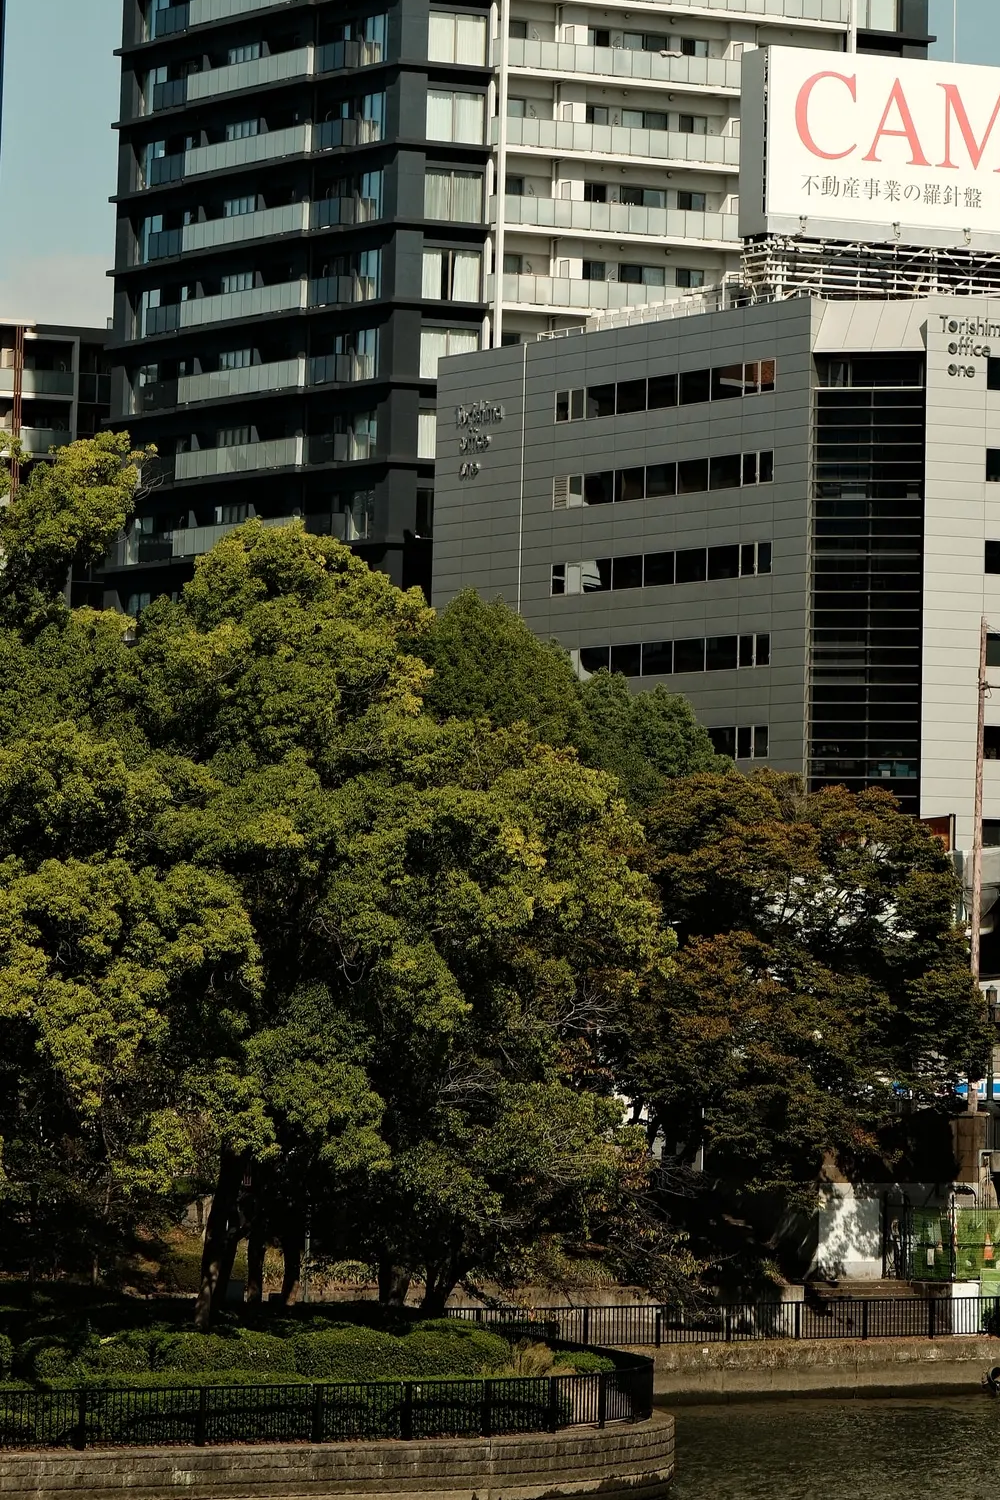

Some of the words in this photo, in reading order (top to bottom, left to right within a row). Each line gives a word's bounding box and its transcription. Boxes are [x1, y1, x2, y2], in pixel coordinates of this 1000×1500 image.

[801, 174, 982, 209] 不動産事業の羅針盤
[947, 336, 991, 357] office
[947, 363, 976, 378] one
